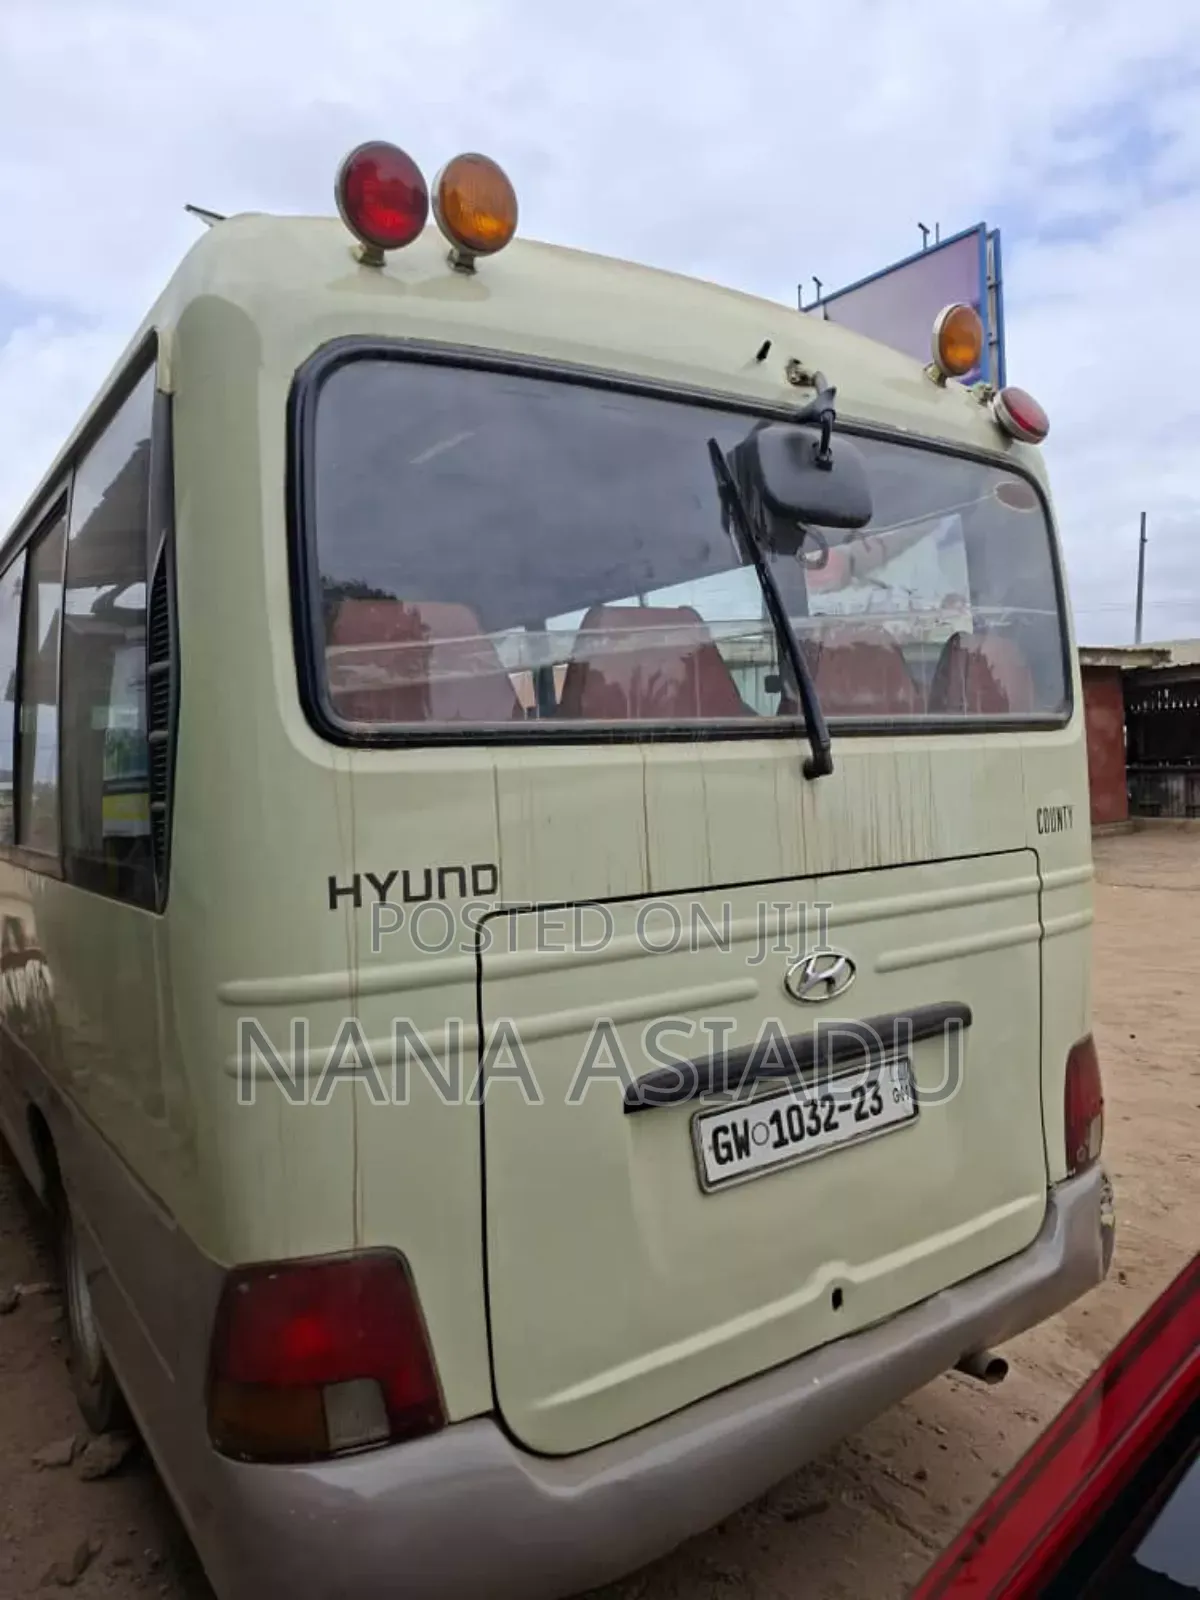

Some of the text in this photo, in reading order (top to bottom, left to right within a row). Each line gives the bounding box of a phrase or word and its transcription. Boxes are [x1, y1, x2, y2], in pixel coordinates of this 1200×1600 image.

[1036, 805, 1073, 834] COUNTY
[328, 863, 498, 910] HYUND
[711, 1079, 884, 1166] GW 1032-23
